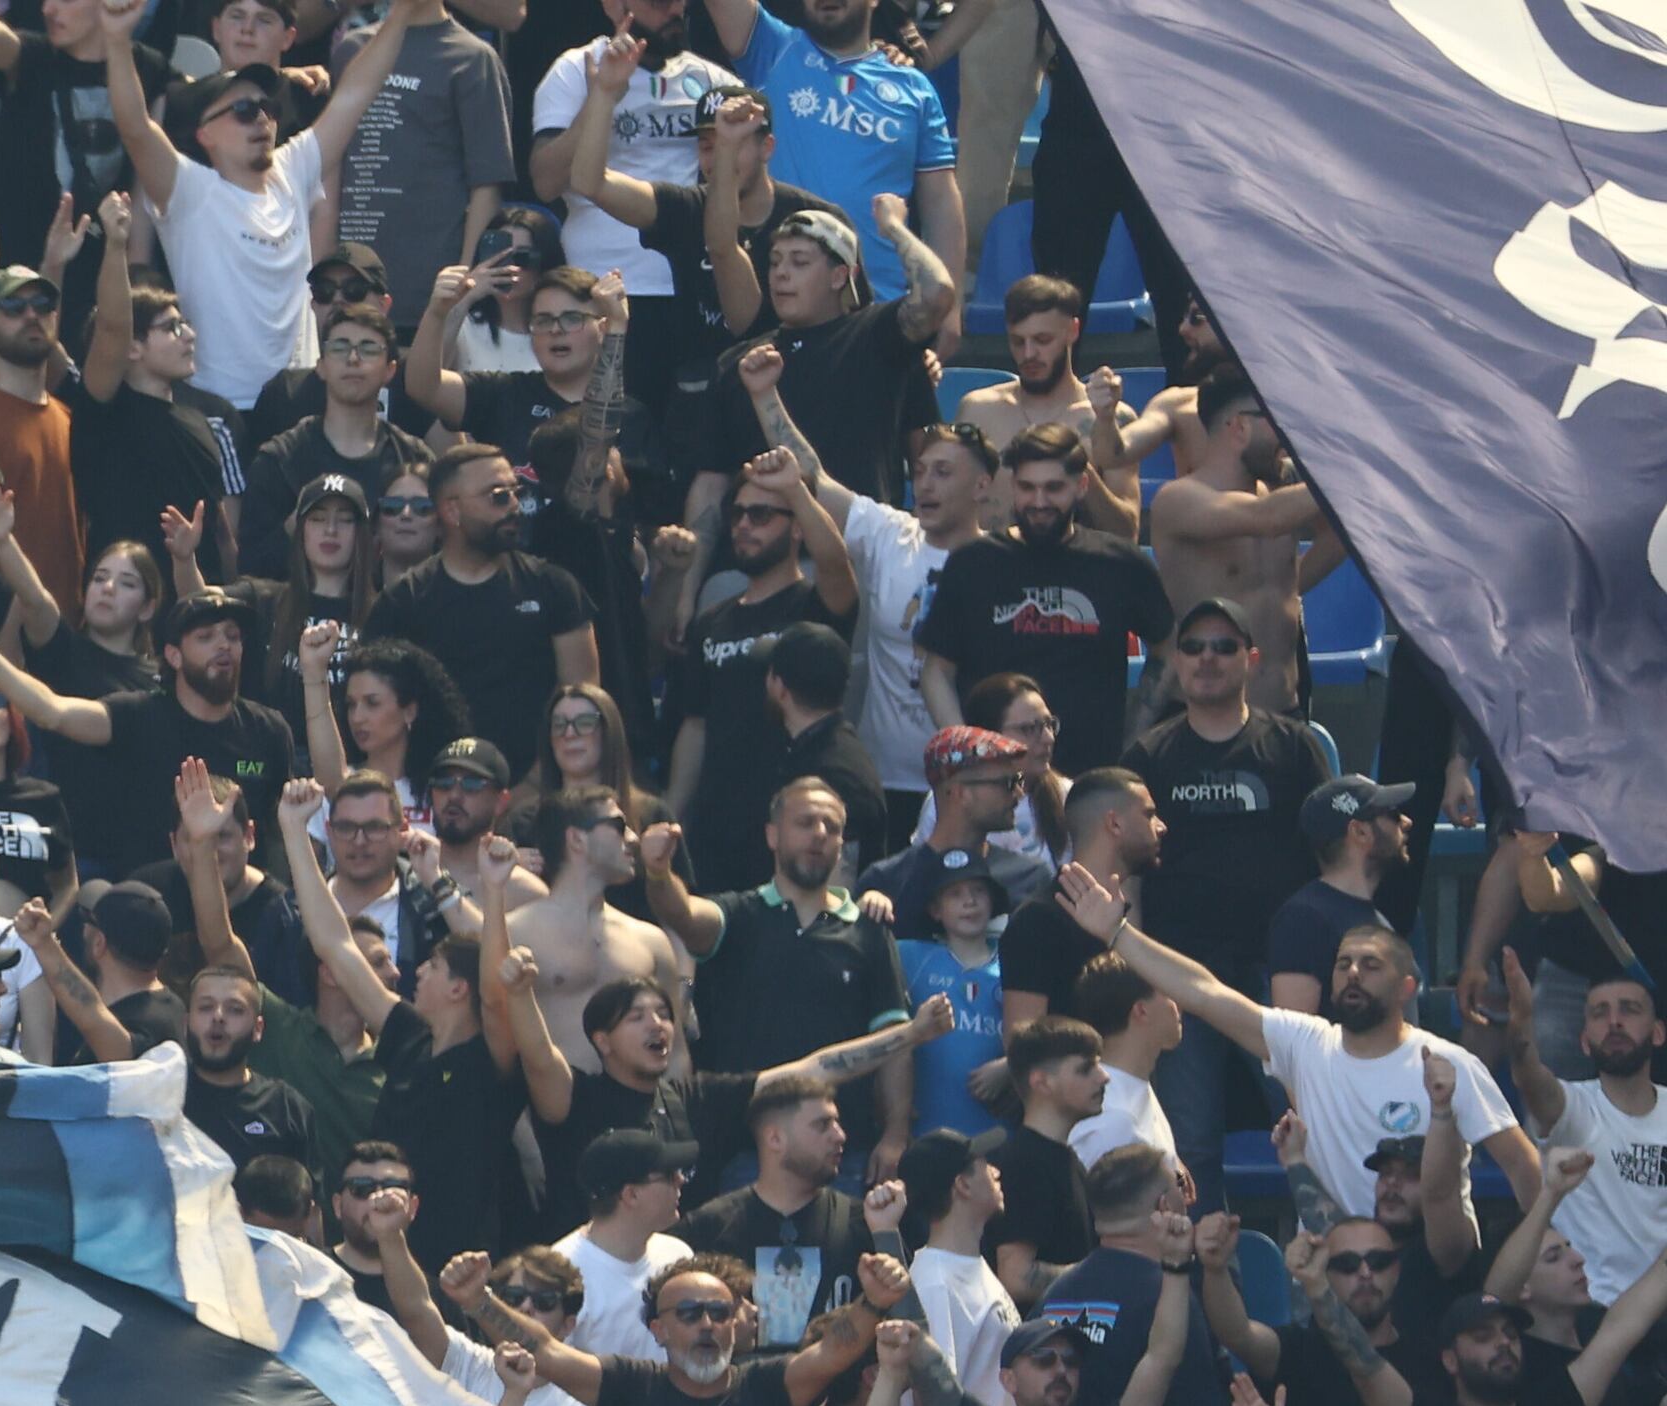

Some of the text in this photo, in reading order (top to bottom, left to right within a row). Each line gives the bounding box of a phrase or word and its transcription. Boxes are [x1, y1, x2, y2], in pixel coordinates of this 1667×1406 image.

[646, 111, 698, 138] MS
[819, 96, 902, 143] MSC
[235, 759, 265, 776] EA7
[1171, 783, 1236, 802] NORTH
